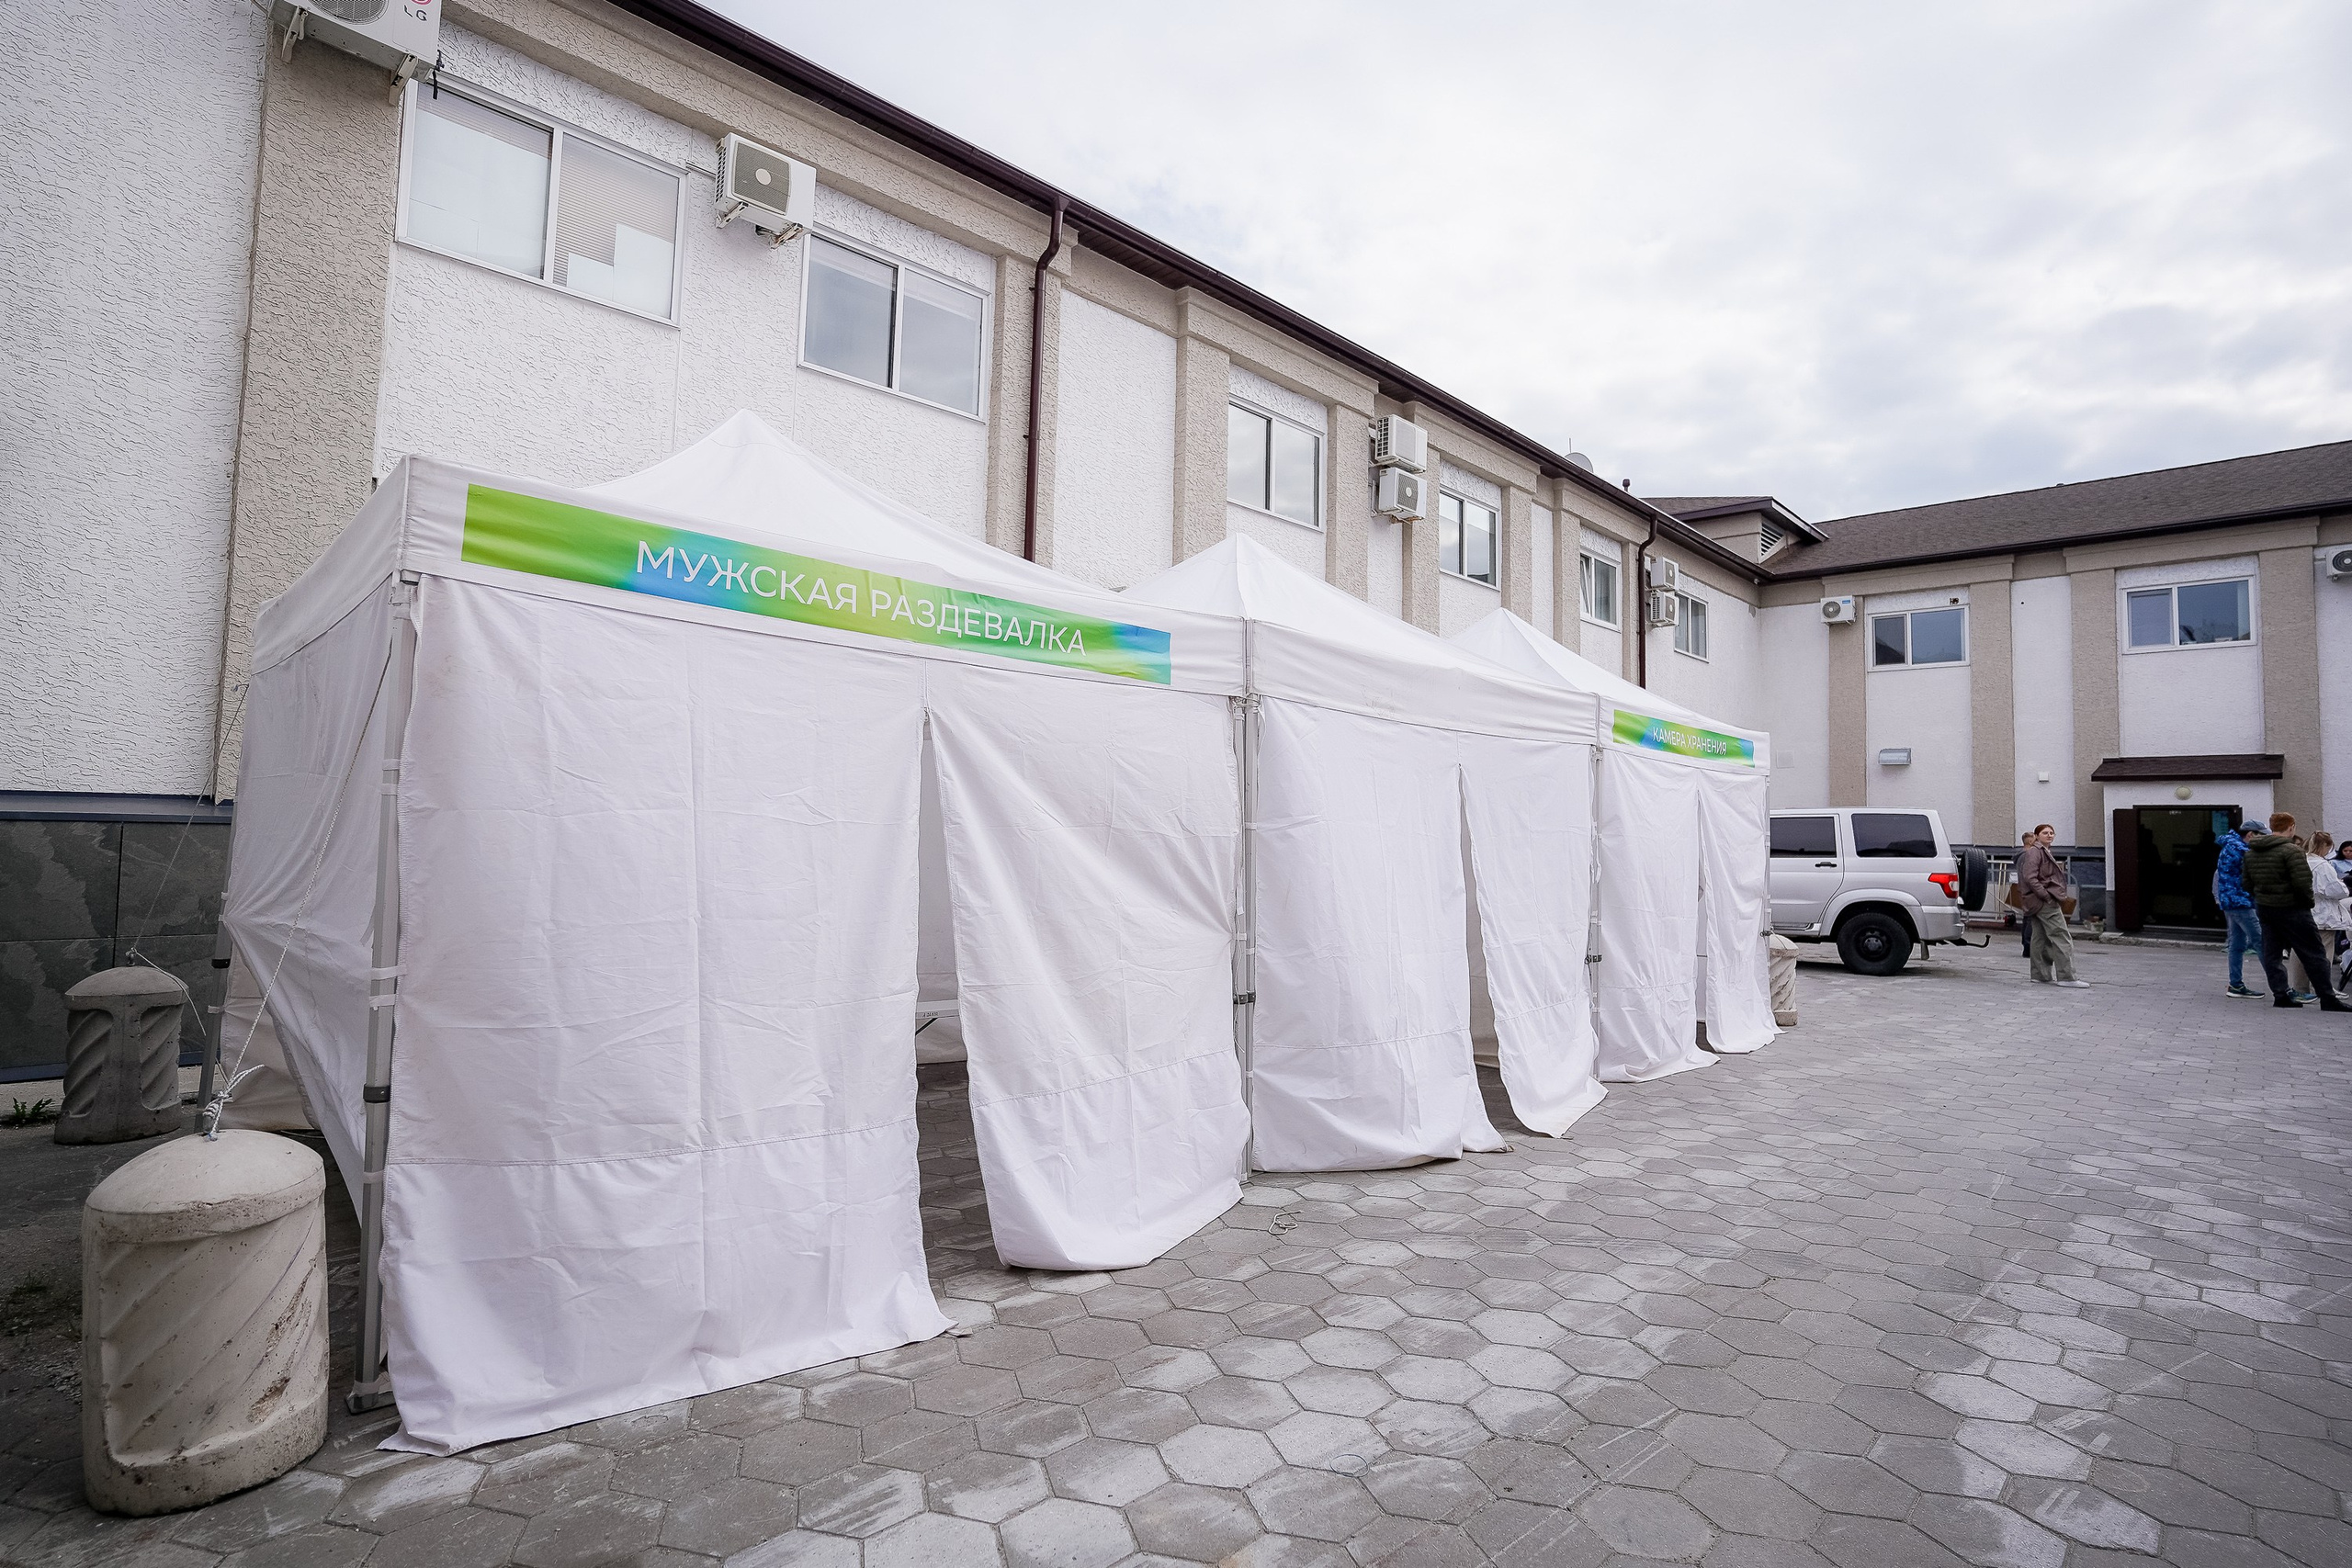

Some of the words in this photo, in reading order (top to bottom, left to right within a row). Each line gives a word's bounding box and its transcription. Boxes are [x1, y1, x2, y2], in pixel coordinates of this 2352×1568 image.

[403, 5, 427, 21] LG
[636, 540, 857, 614] МУЖСКАЯ
[871, 589, 1087, 657] РАЗДЕВАЛКА
[1653, 727, 1686, 749] КАМЕРА
[1687, 735, 1727, 755] ХРАНЕНИЯ
